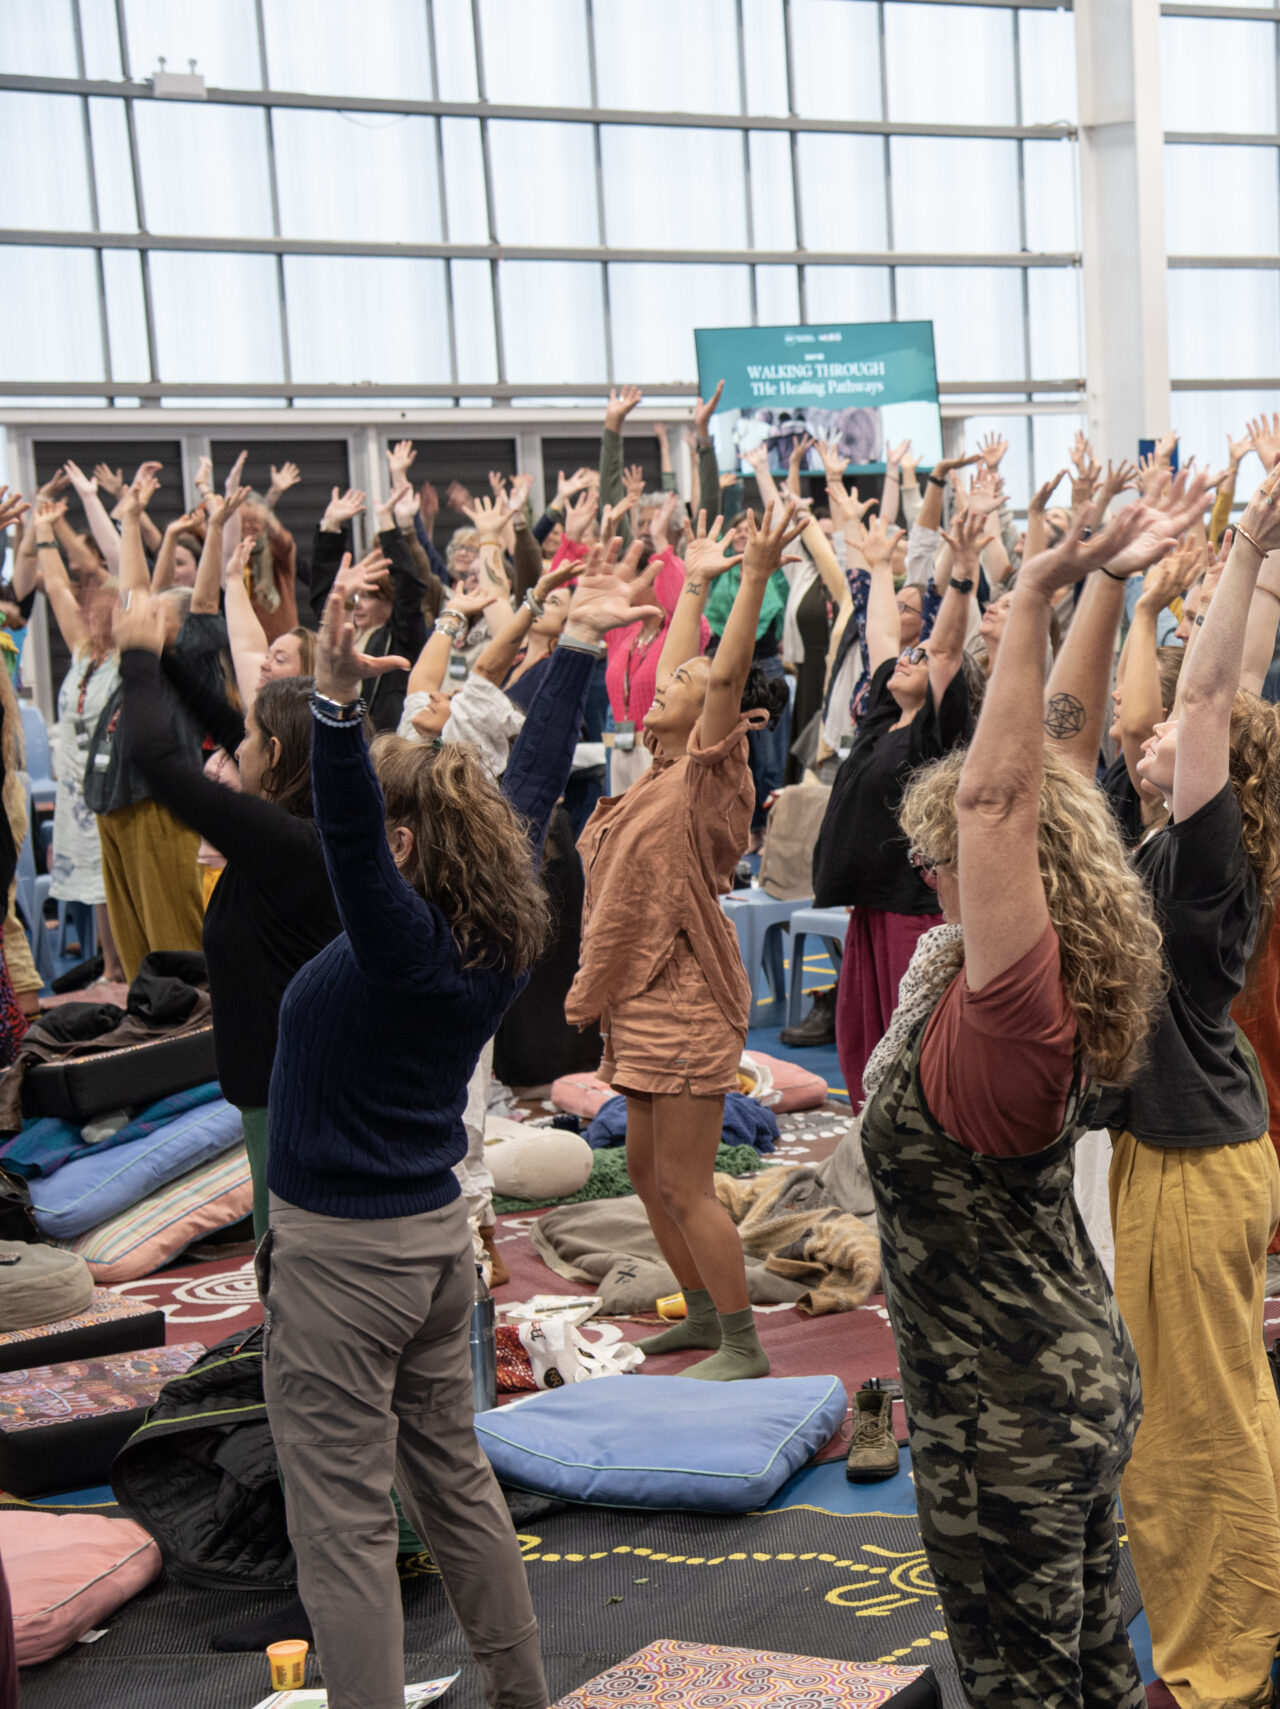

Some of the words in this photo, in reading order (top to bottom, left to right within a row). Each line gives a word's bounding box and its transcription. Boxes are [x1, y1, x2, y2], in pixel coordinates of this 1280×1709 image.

[747, 363, 812, 379] WALKING
[814, 361, 885, 378] THROUGH
[780, 379, 826, 398] Healing
[827, 378, 884, 396] Pathways
